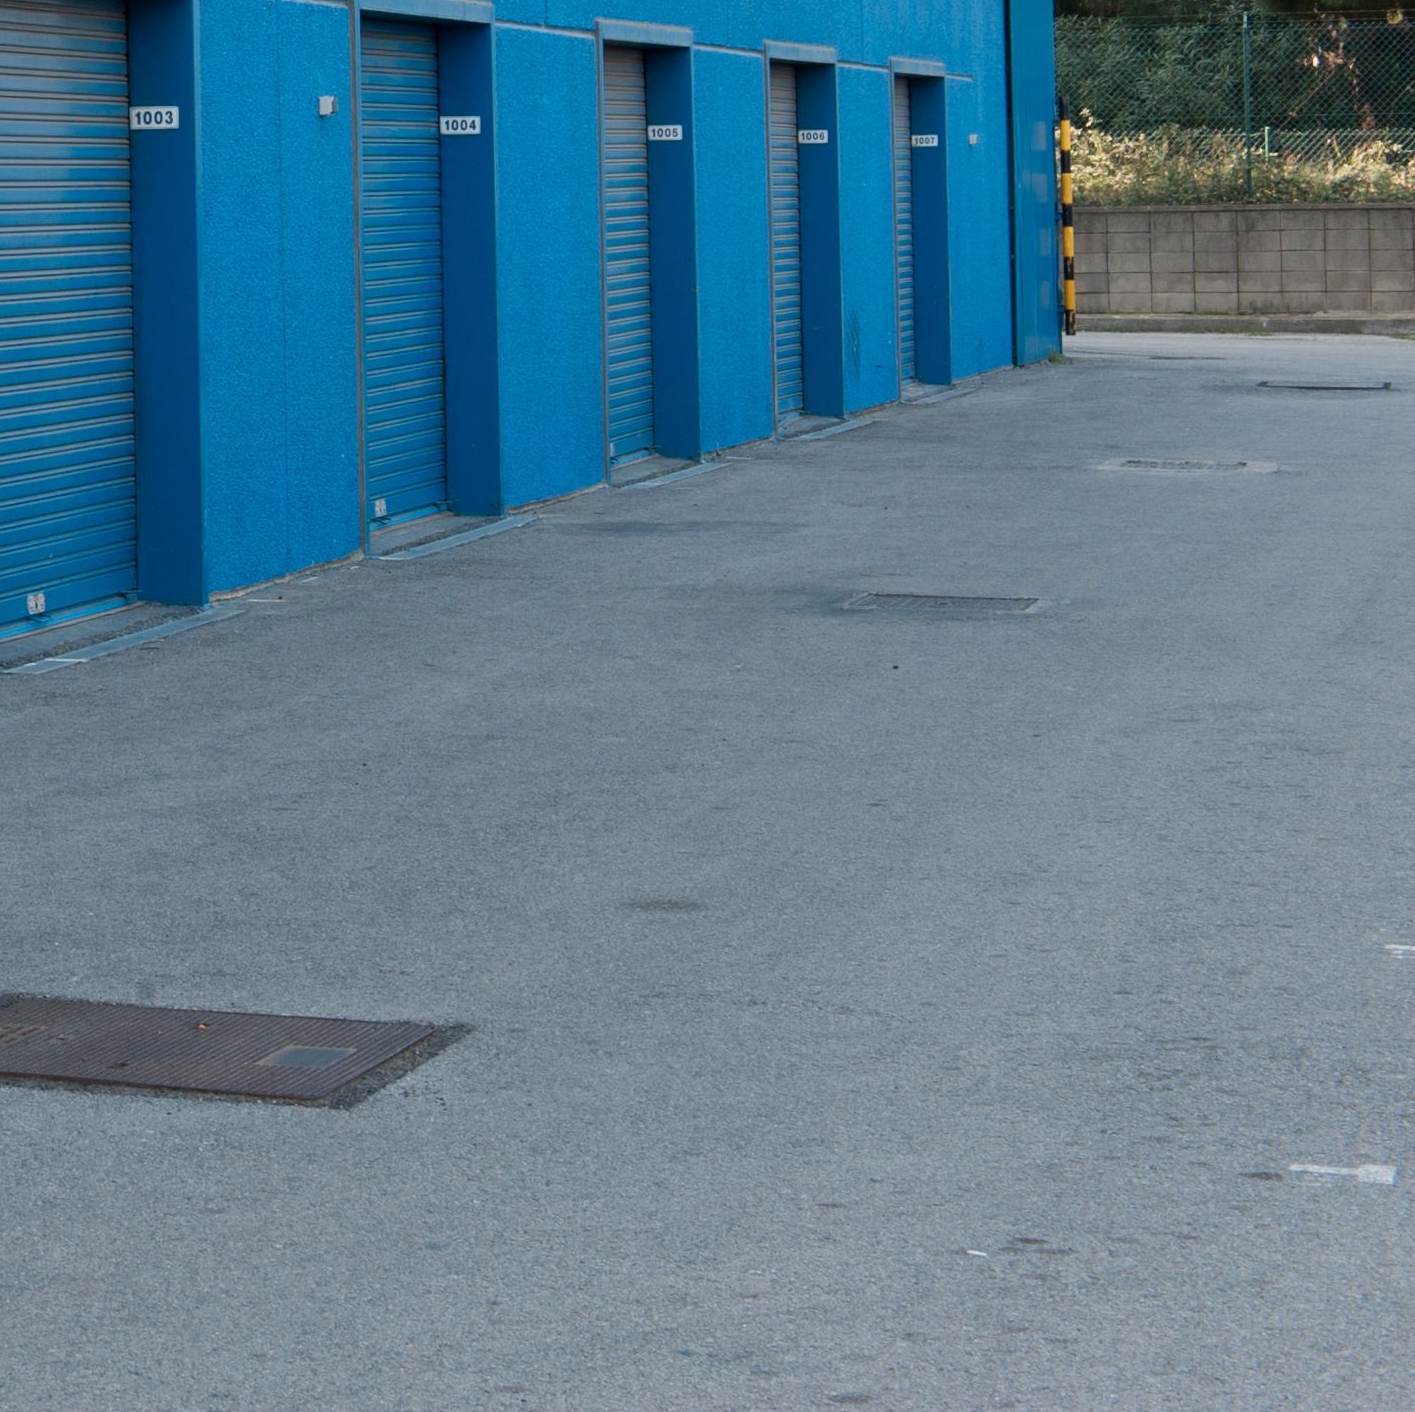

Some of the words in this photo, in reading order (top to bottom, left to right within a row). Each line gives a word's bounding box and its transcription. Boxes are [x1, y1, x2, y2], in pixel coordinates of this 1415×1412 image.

[135, 110, 174, 125] 1003
[444, 119, 477, 131] 1004
[651, 128, 679, 138] 1005
[801, 132, 825, 141] 1006
[914, 137, 935, 145] 1007
